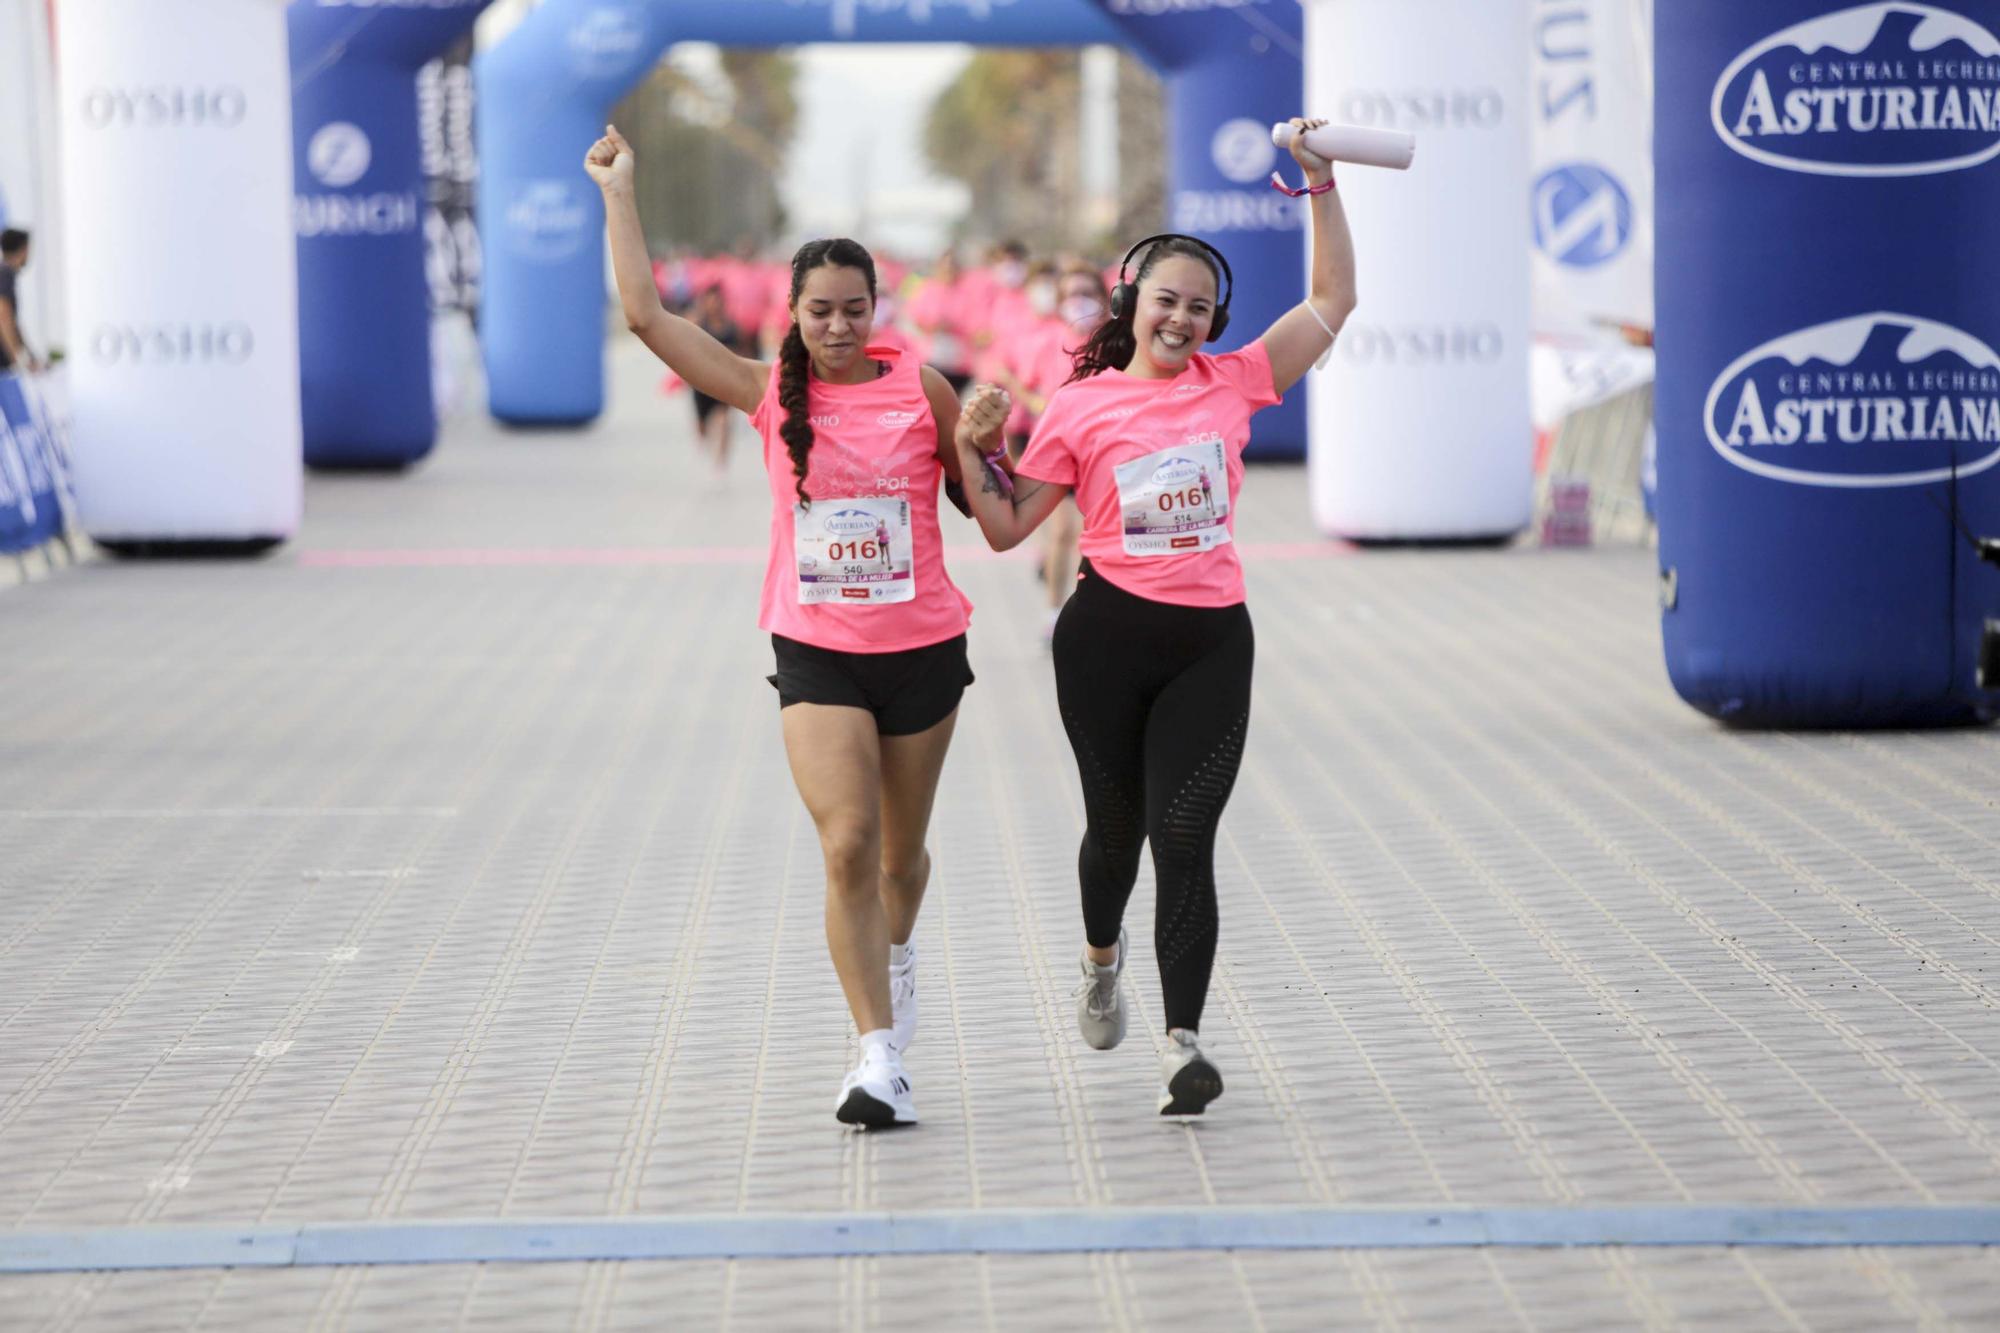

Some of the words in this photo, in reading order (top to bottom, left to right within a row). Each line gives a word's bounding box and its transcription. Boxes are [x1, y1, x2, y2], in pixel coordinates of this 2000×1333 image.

[1789, 61, 1906, 83] CENTRAL
[81, 84, 247, 129] OYSHO
[1340, 86, 1503, 128] OYSHO
[296, 193, 417, 236] URICH
[1175, 190, 1304, 232] ZURIC
[90, 321, 254, 367] OYSHO
[1342, 321, 1503, 367] OYSHO
[1778, 371, 1895, 394] CENTRAL
[811, 415, 840, 427] SHO
[1726, 378, 2000, 445] ASTURIANA
[876, 477, 910, 490] POR
[1158, 488, 1202, 511] 016
[1175, 514, 1192, 524] 514
[829, 541, 877, 560] 016
[844, 565, 862, 574] 540
